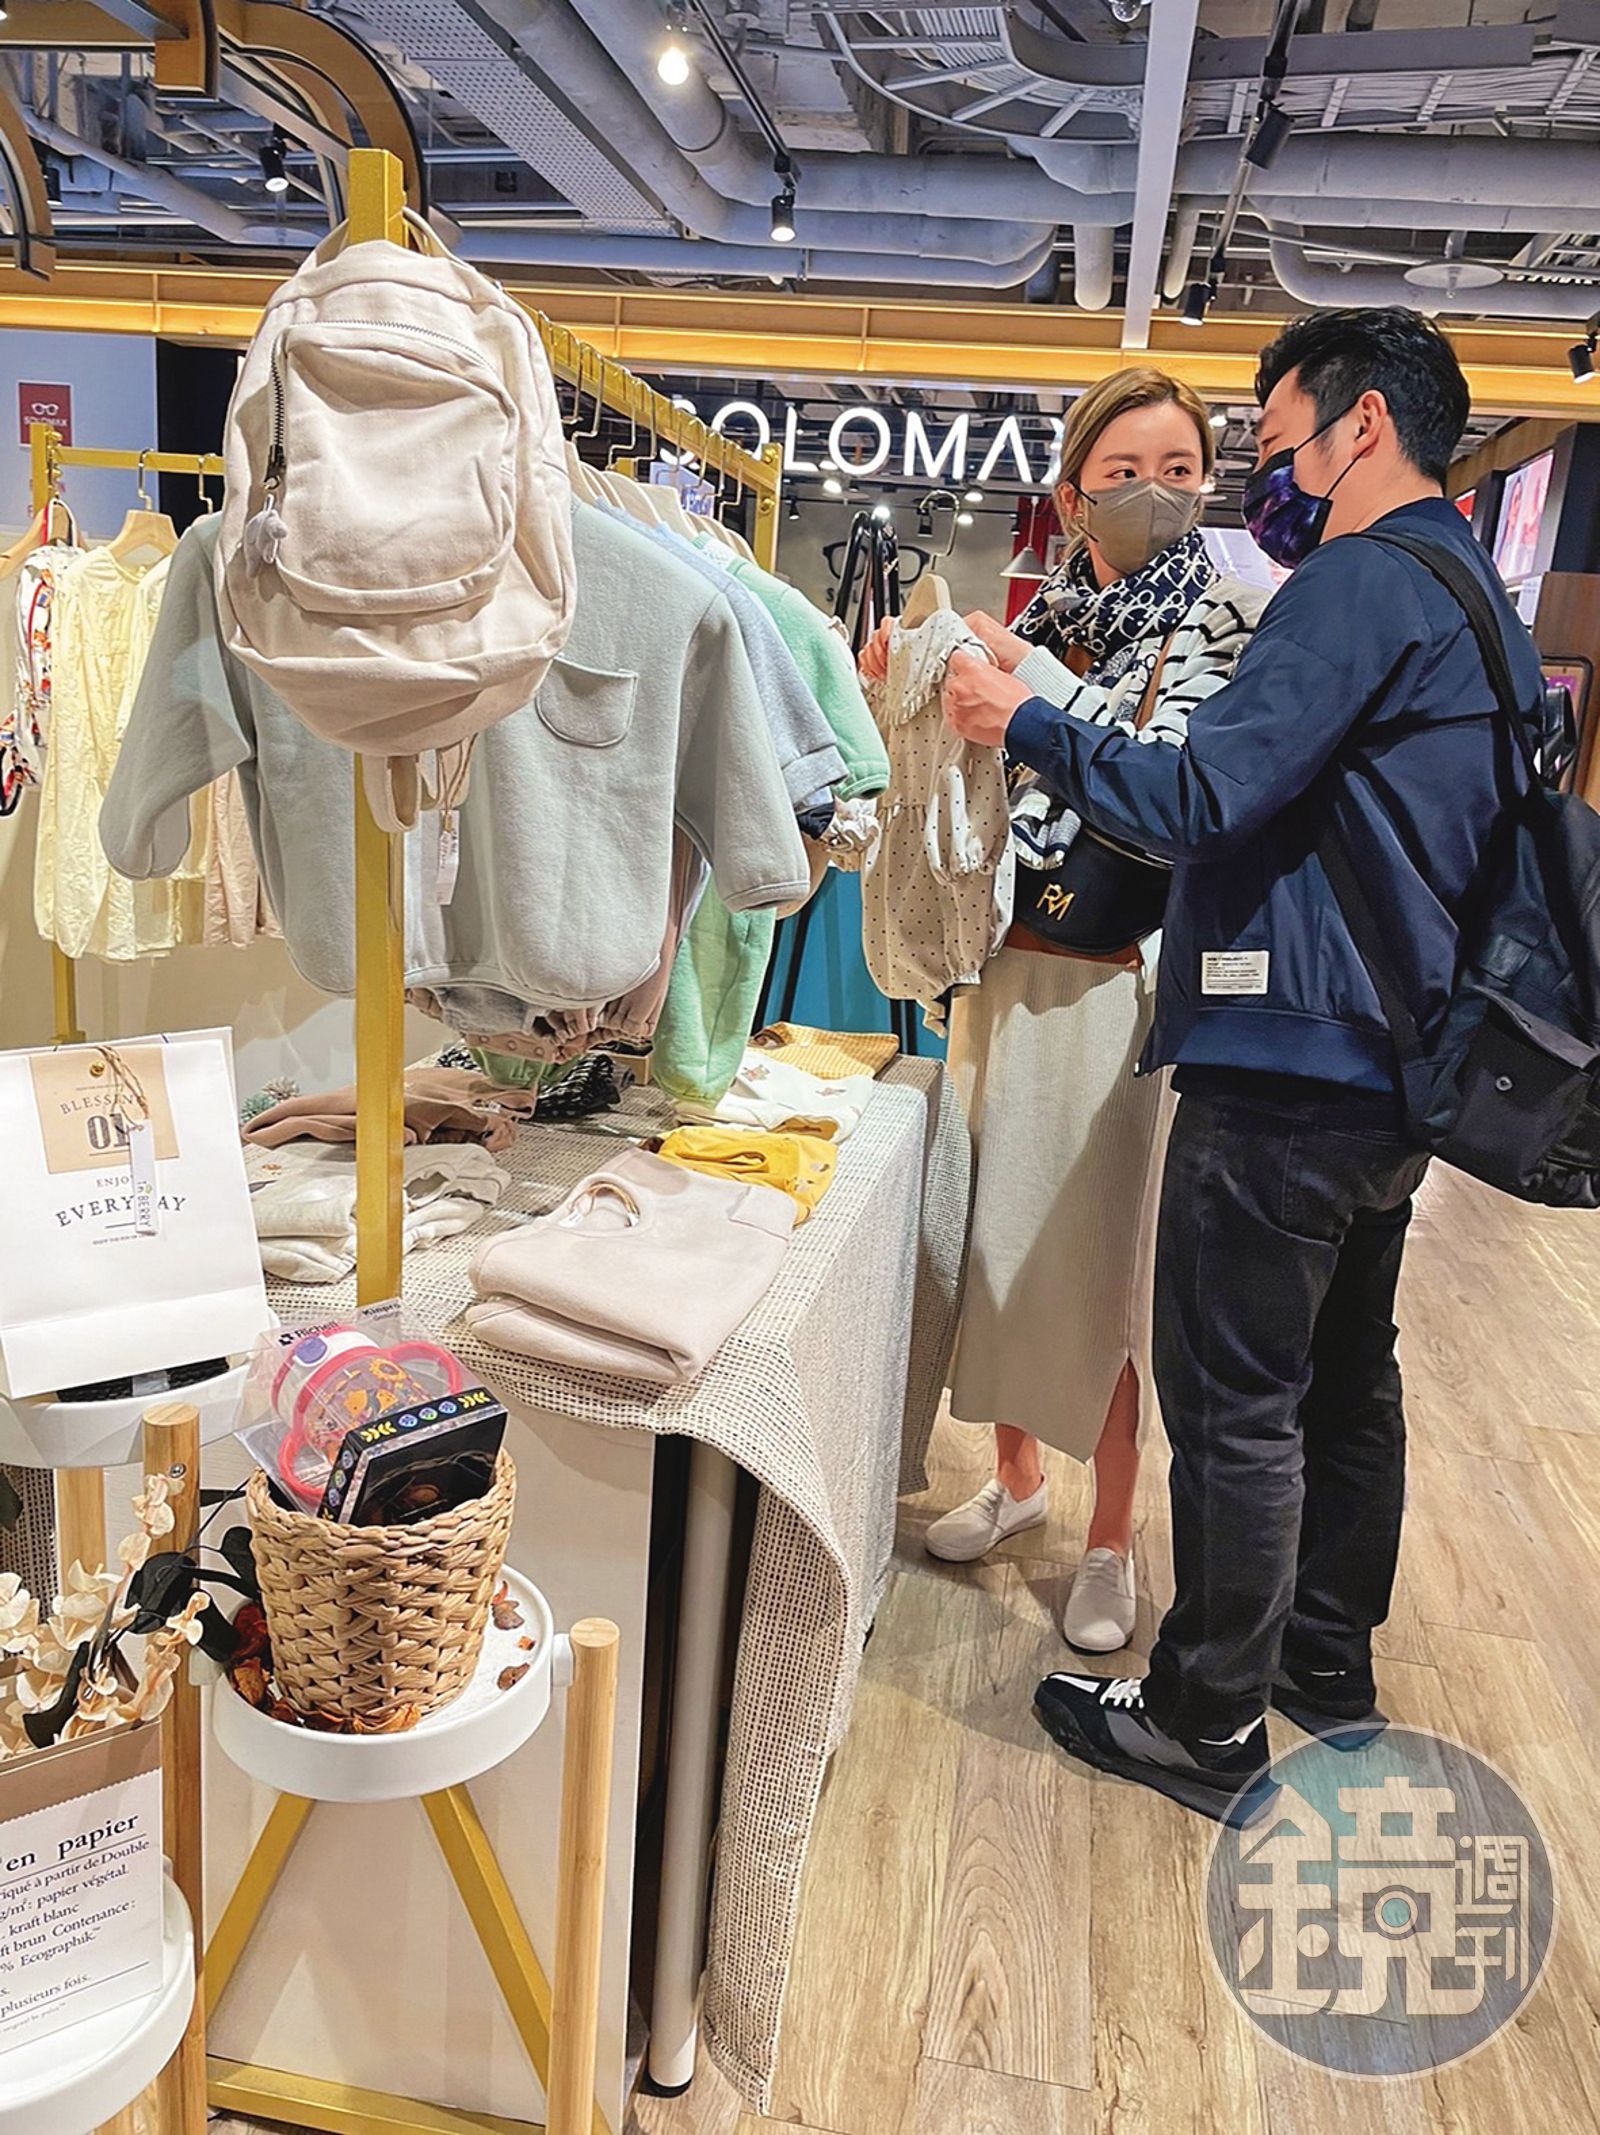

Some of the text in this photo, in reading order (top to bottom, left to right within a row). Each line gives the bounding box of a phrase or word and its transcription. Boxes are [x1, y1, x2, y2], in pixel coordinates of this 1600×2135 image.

[60, 1092, 135, 1114] BLESSIN
[96, 1174, 134, 1188] ENJO
[55, 1195, 186, 1227] EVERYAY
[58, 1815, 139, 1861] papier
[45, 1864, 81, 1887] partir
[101, 1841, 150, 1864] Double
[37, 1884, 79, 1909] papier
[9, 1903, 80, 1936] kraft blanc
[13, 1934, 47, 1953] brun
[1, 1984, 61, 2018] plusieurs
